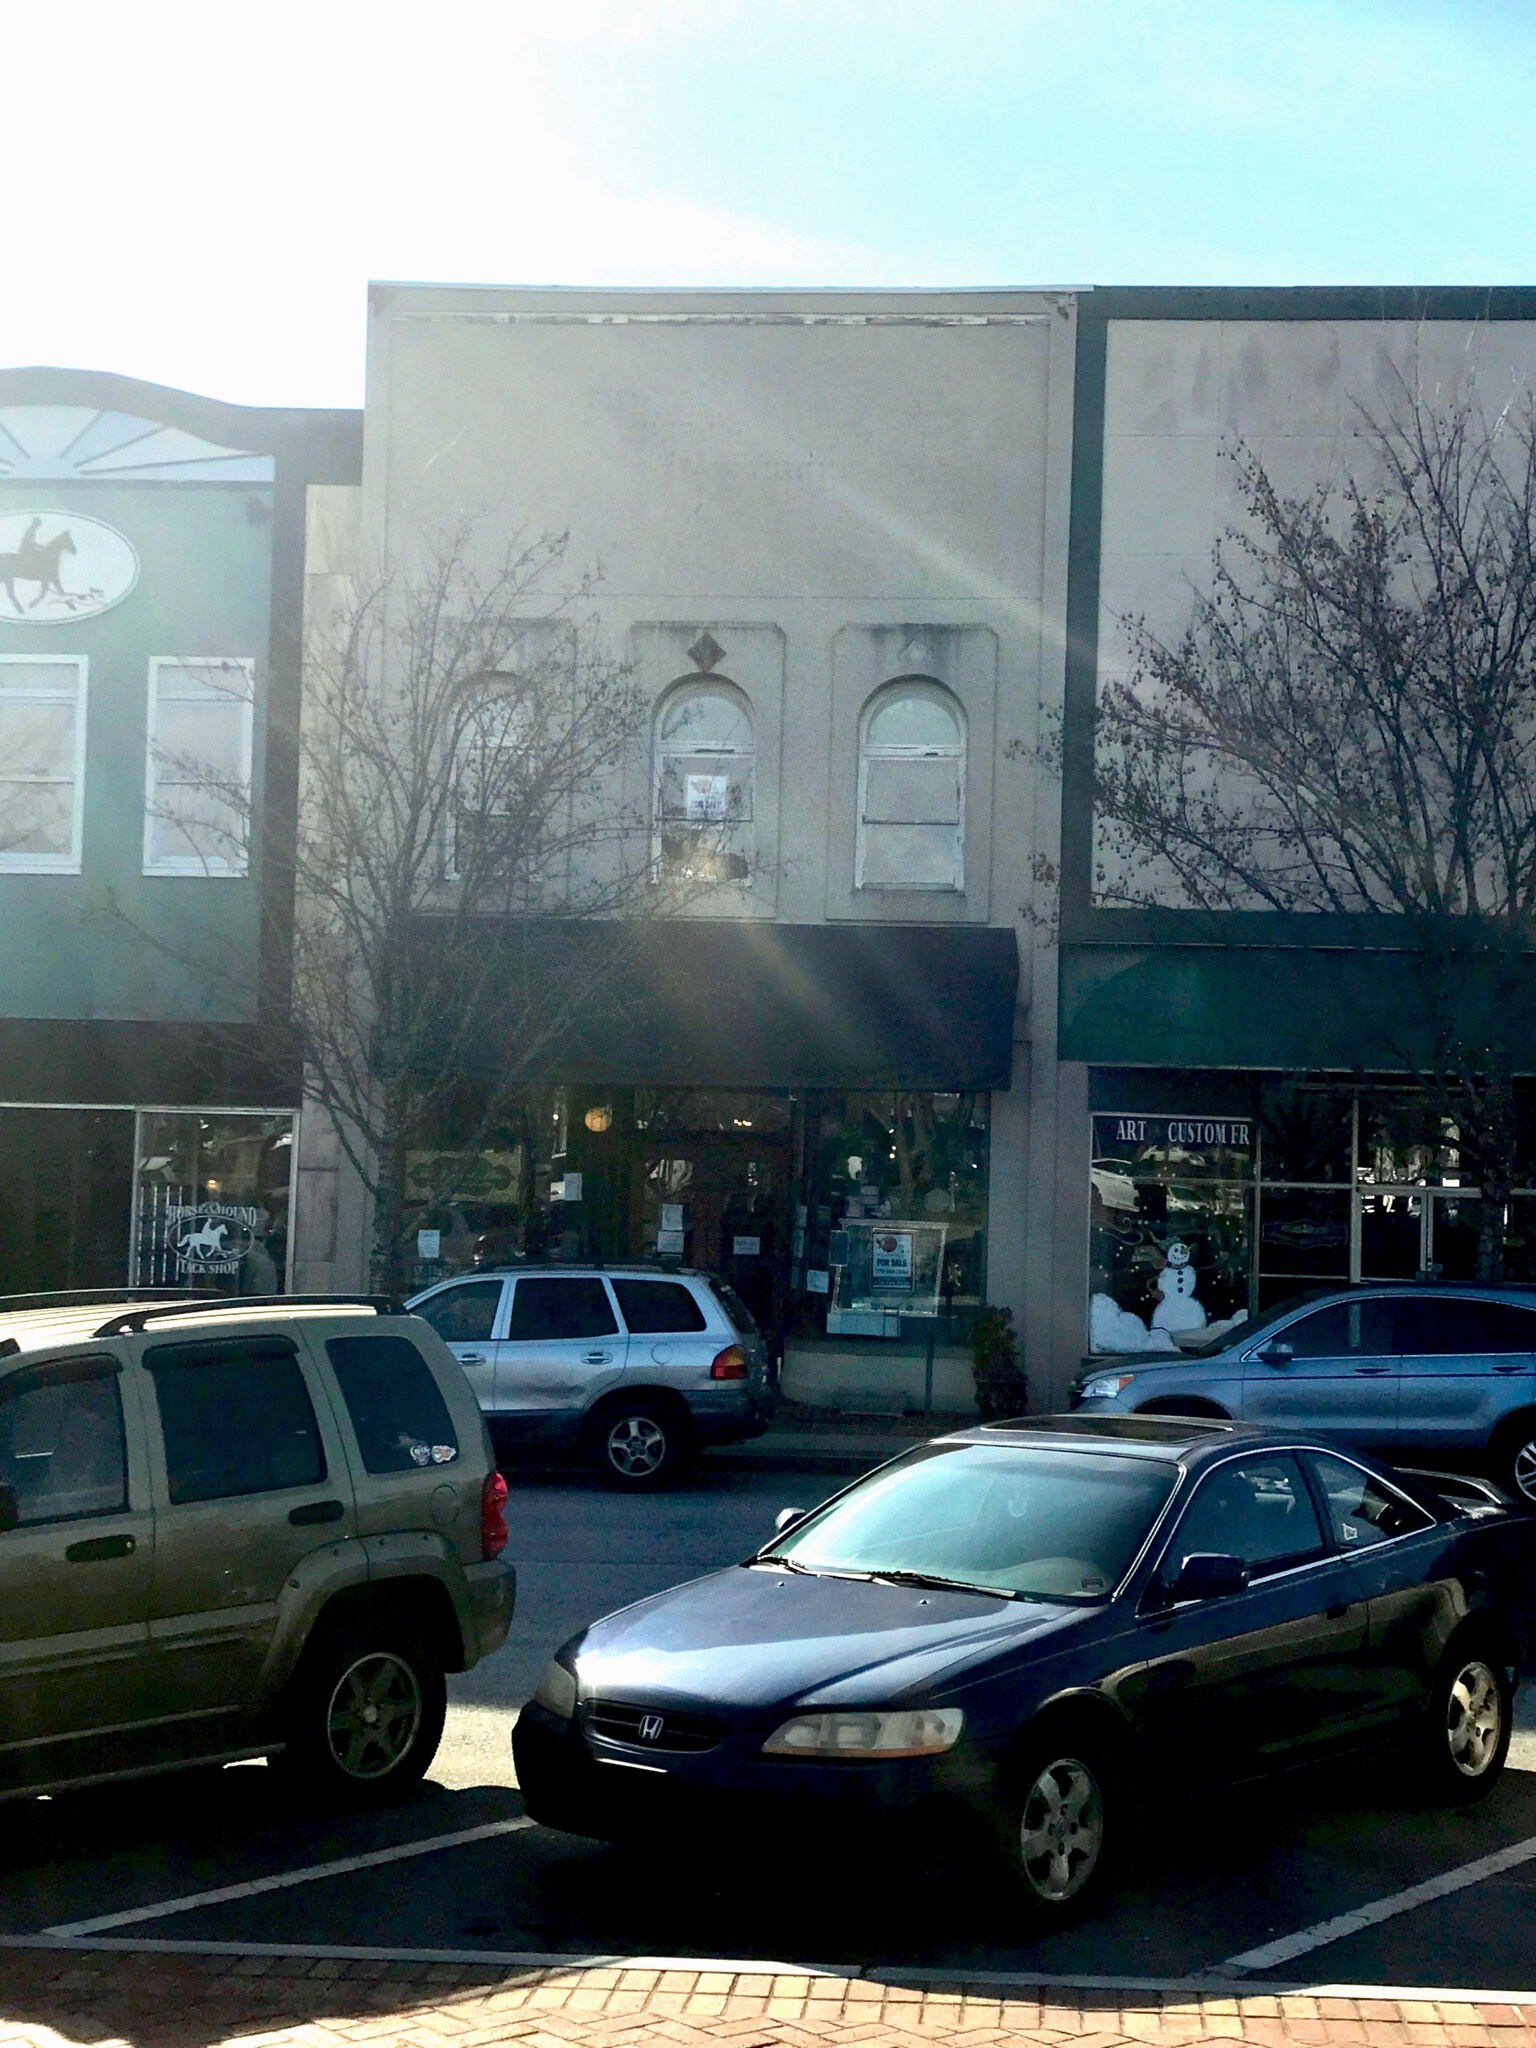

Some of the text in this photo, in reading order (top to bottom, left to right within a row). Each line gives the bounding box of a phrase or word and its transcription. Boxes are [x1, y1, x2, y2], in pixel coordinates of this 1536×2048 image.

[1116, 1120, 1250, 1145] ART CUSTOM FR
[181, 1258, 239, 1275] TACK SHOP
[877, 1258, 908, 1268] FOR SALE
